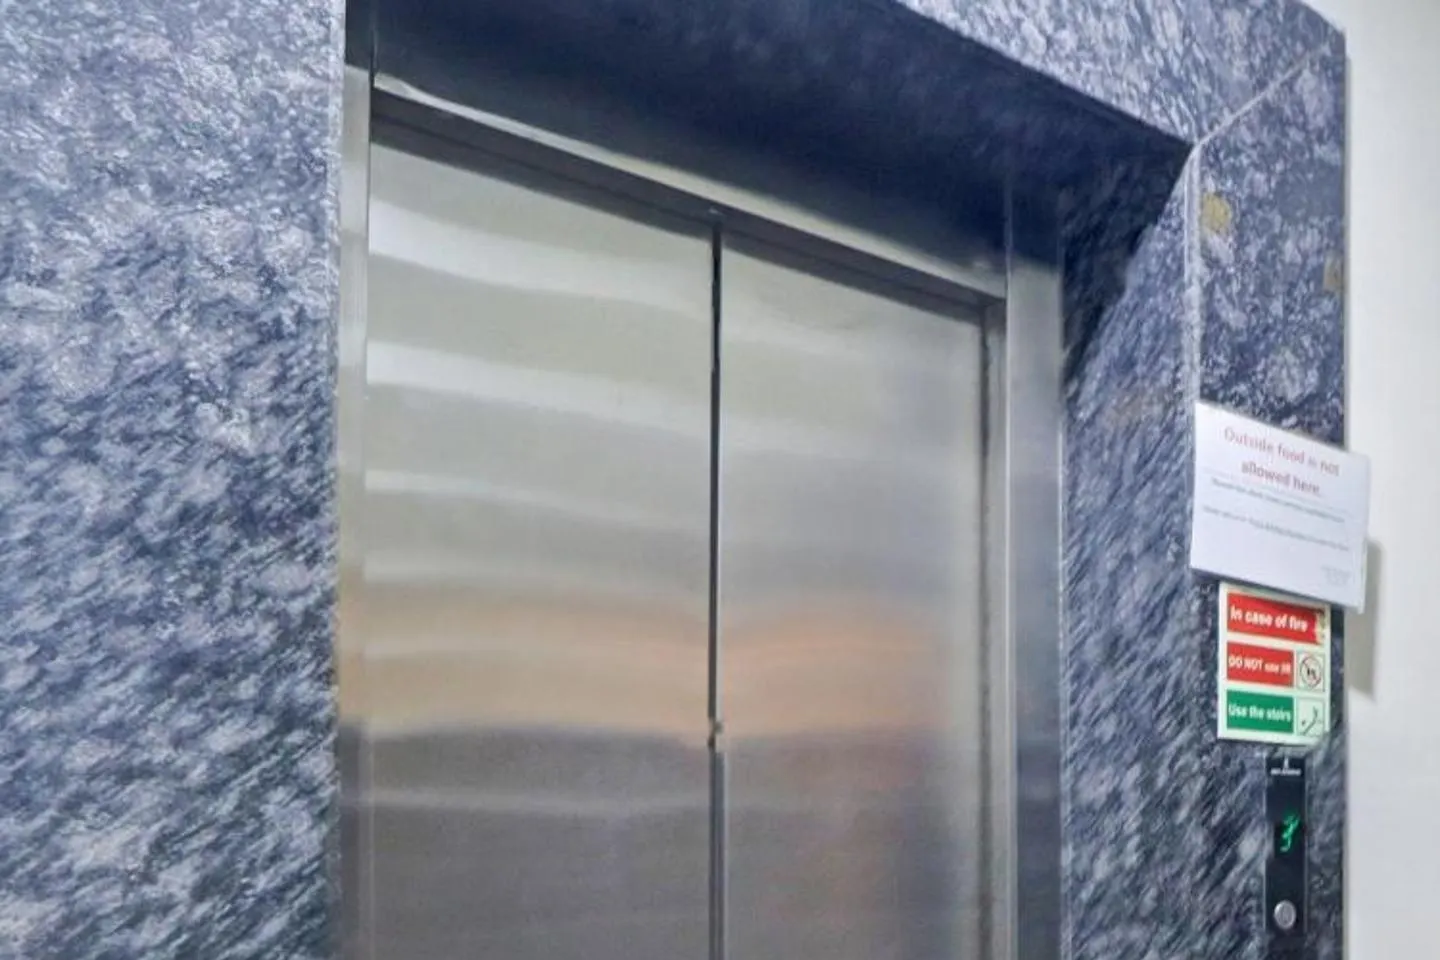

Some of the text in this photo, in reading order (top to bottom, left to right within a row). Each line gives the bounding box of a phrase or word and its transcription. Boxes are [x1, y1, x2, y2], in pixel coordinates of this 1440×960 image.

[1224, 427, 1275, 453] Outside
[1278, 444, 1305, 464] food
[1320, 462, 1340, 477] not
[1241, 460, 1290, 488] allowed
[1230, 604, 1308, 632] In case of fire
[1228, 654, 1243, 669] DO
[1244, 657, 1263, 671] NOT
[1228, 702, 1291, 722] Use the stairs
